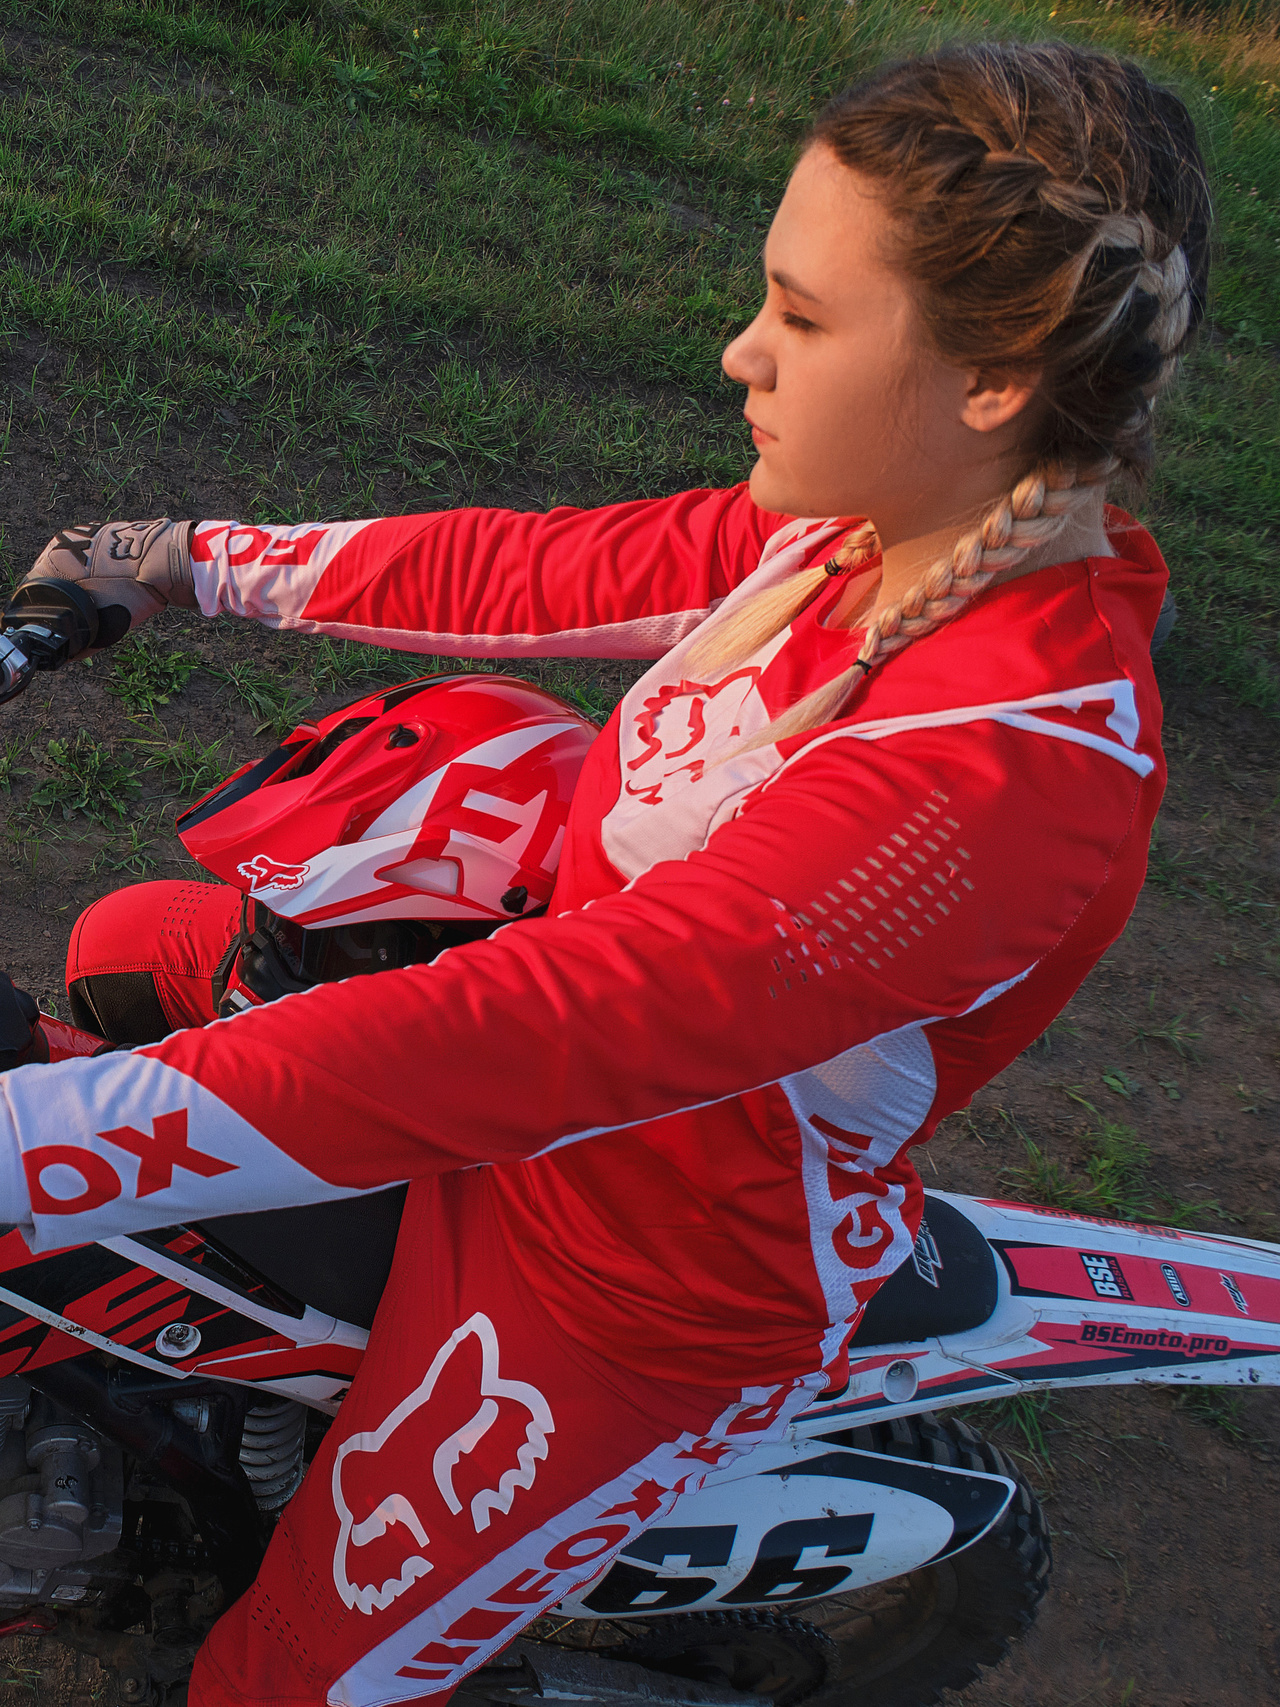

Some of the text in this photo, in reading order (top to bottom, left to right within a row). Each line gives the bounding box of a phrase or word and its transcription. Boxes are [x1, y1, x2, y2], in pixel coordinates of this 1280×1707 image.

[1081, 1254, 1123, 1298] BSE
[1108, 1259, 1131, 1299] RUSSIA
[1163, 1267, 1188, 1303] ABUS
[1080, 1324, 1229, 1354] BSEmoto.pro
[581, 1513, 875, 1614] 66
